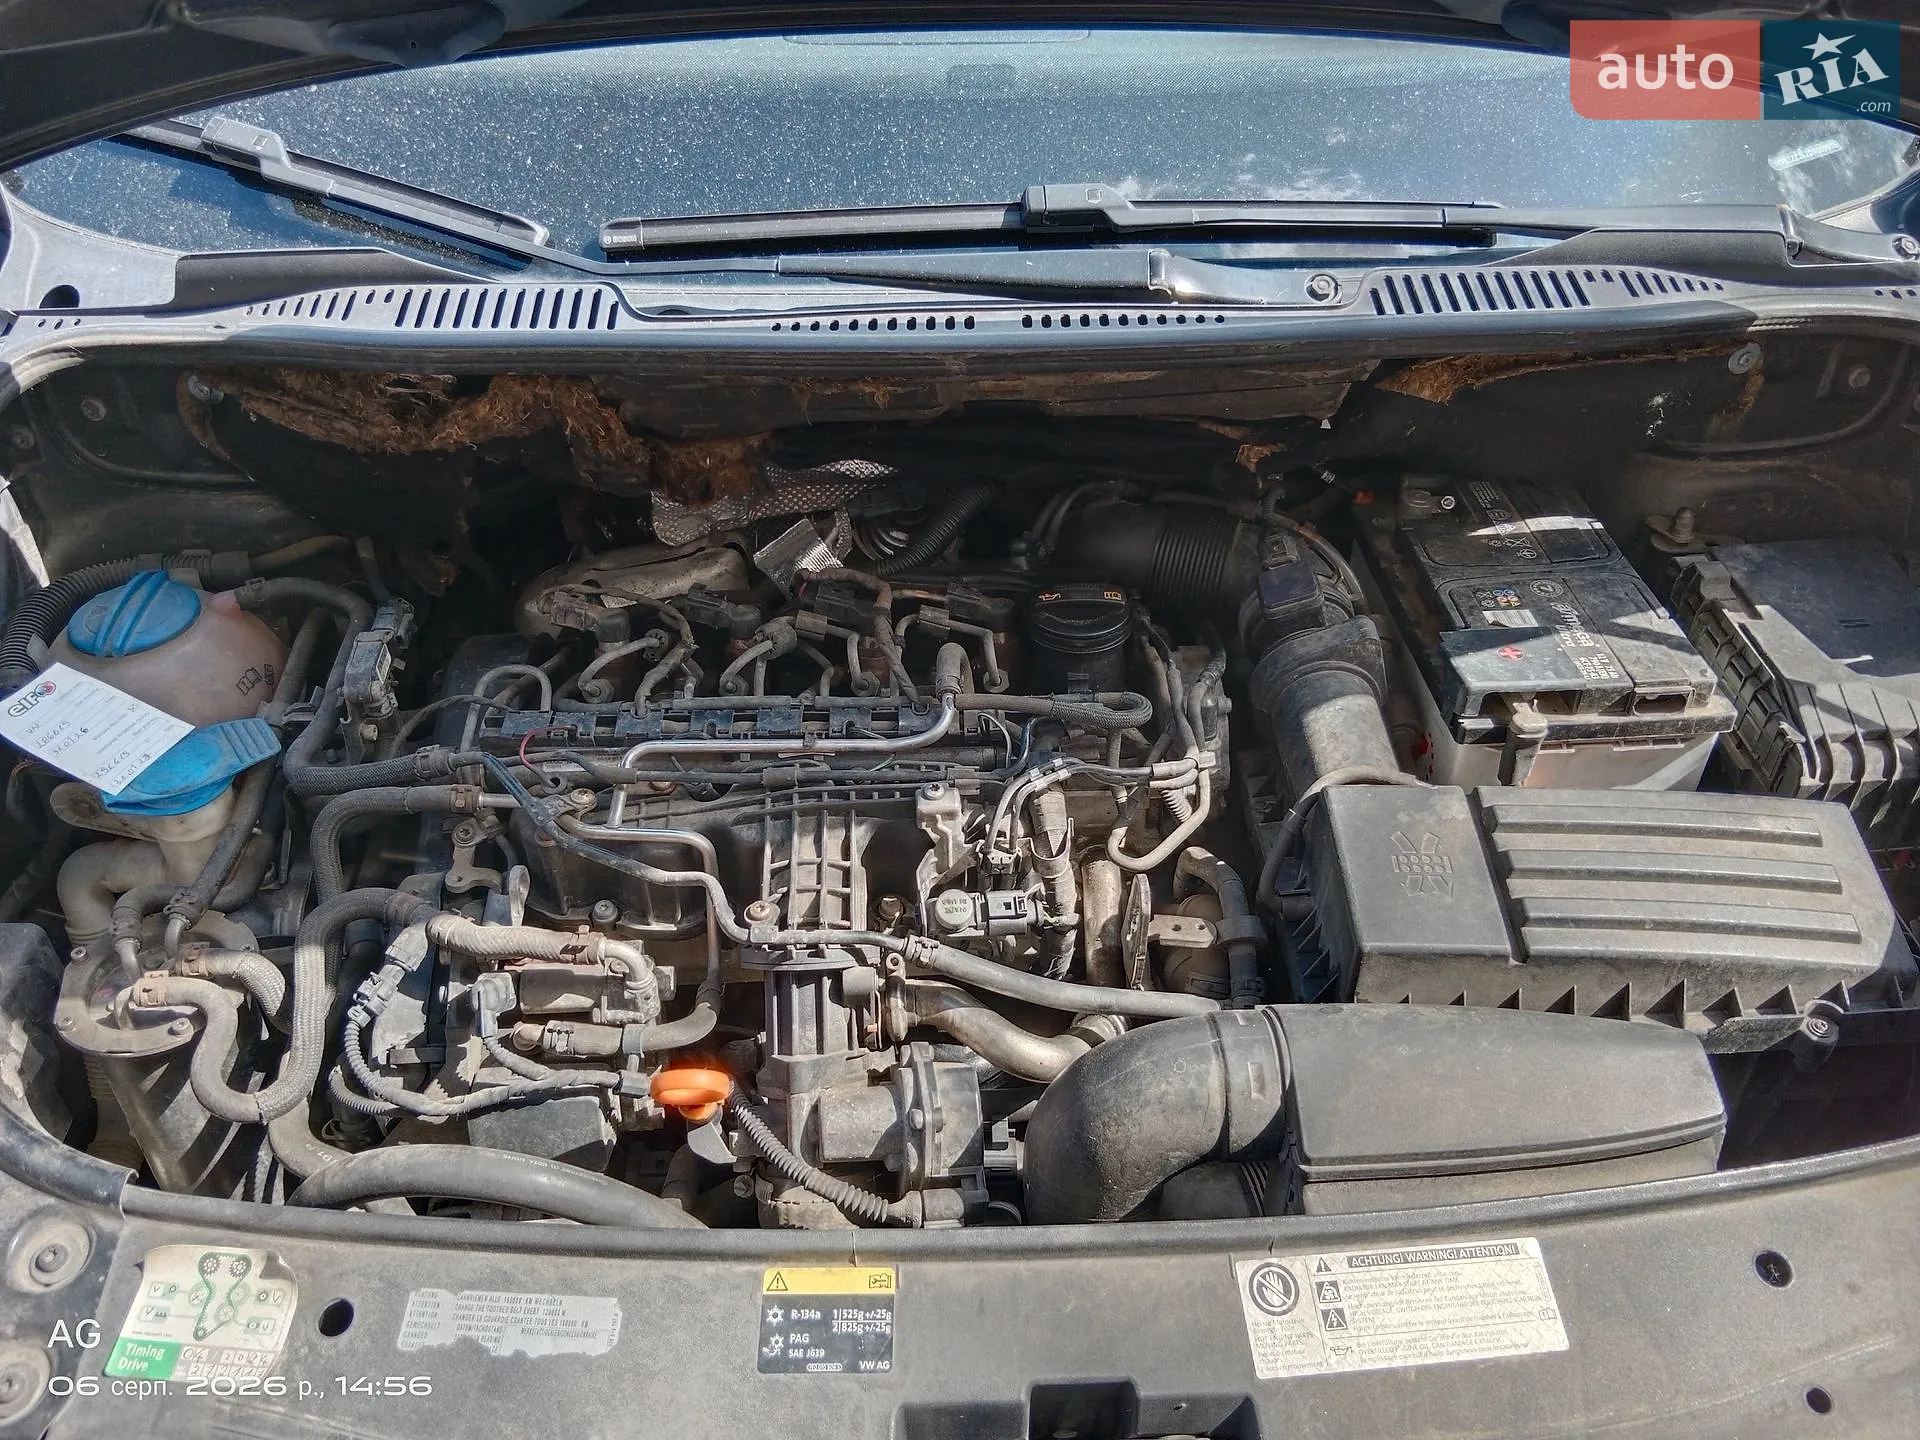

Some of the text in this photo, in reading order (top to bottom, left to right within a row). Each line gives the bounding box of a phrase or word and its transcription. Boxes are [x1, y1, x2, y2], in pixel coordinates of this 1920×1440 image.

[1351, 1244, 1517, 1267] ACHTUNG! WARNING! ATTENTION!
[790, 1308, 821, 1320] R-134a
[789, 1333, 810, 1344] PAG
[126, 1342, 166, 1360] Timing
[788, 1348, 825, 1358] SAE J639
[118, 1356, 149, 1372] Drive
[859, 1360, 890, 1370] VW AG
